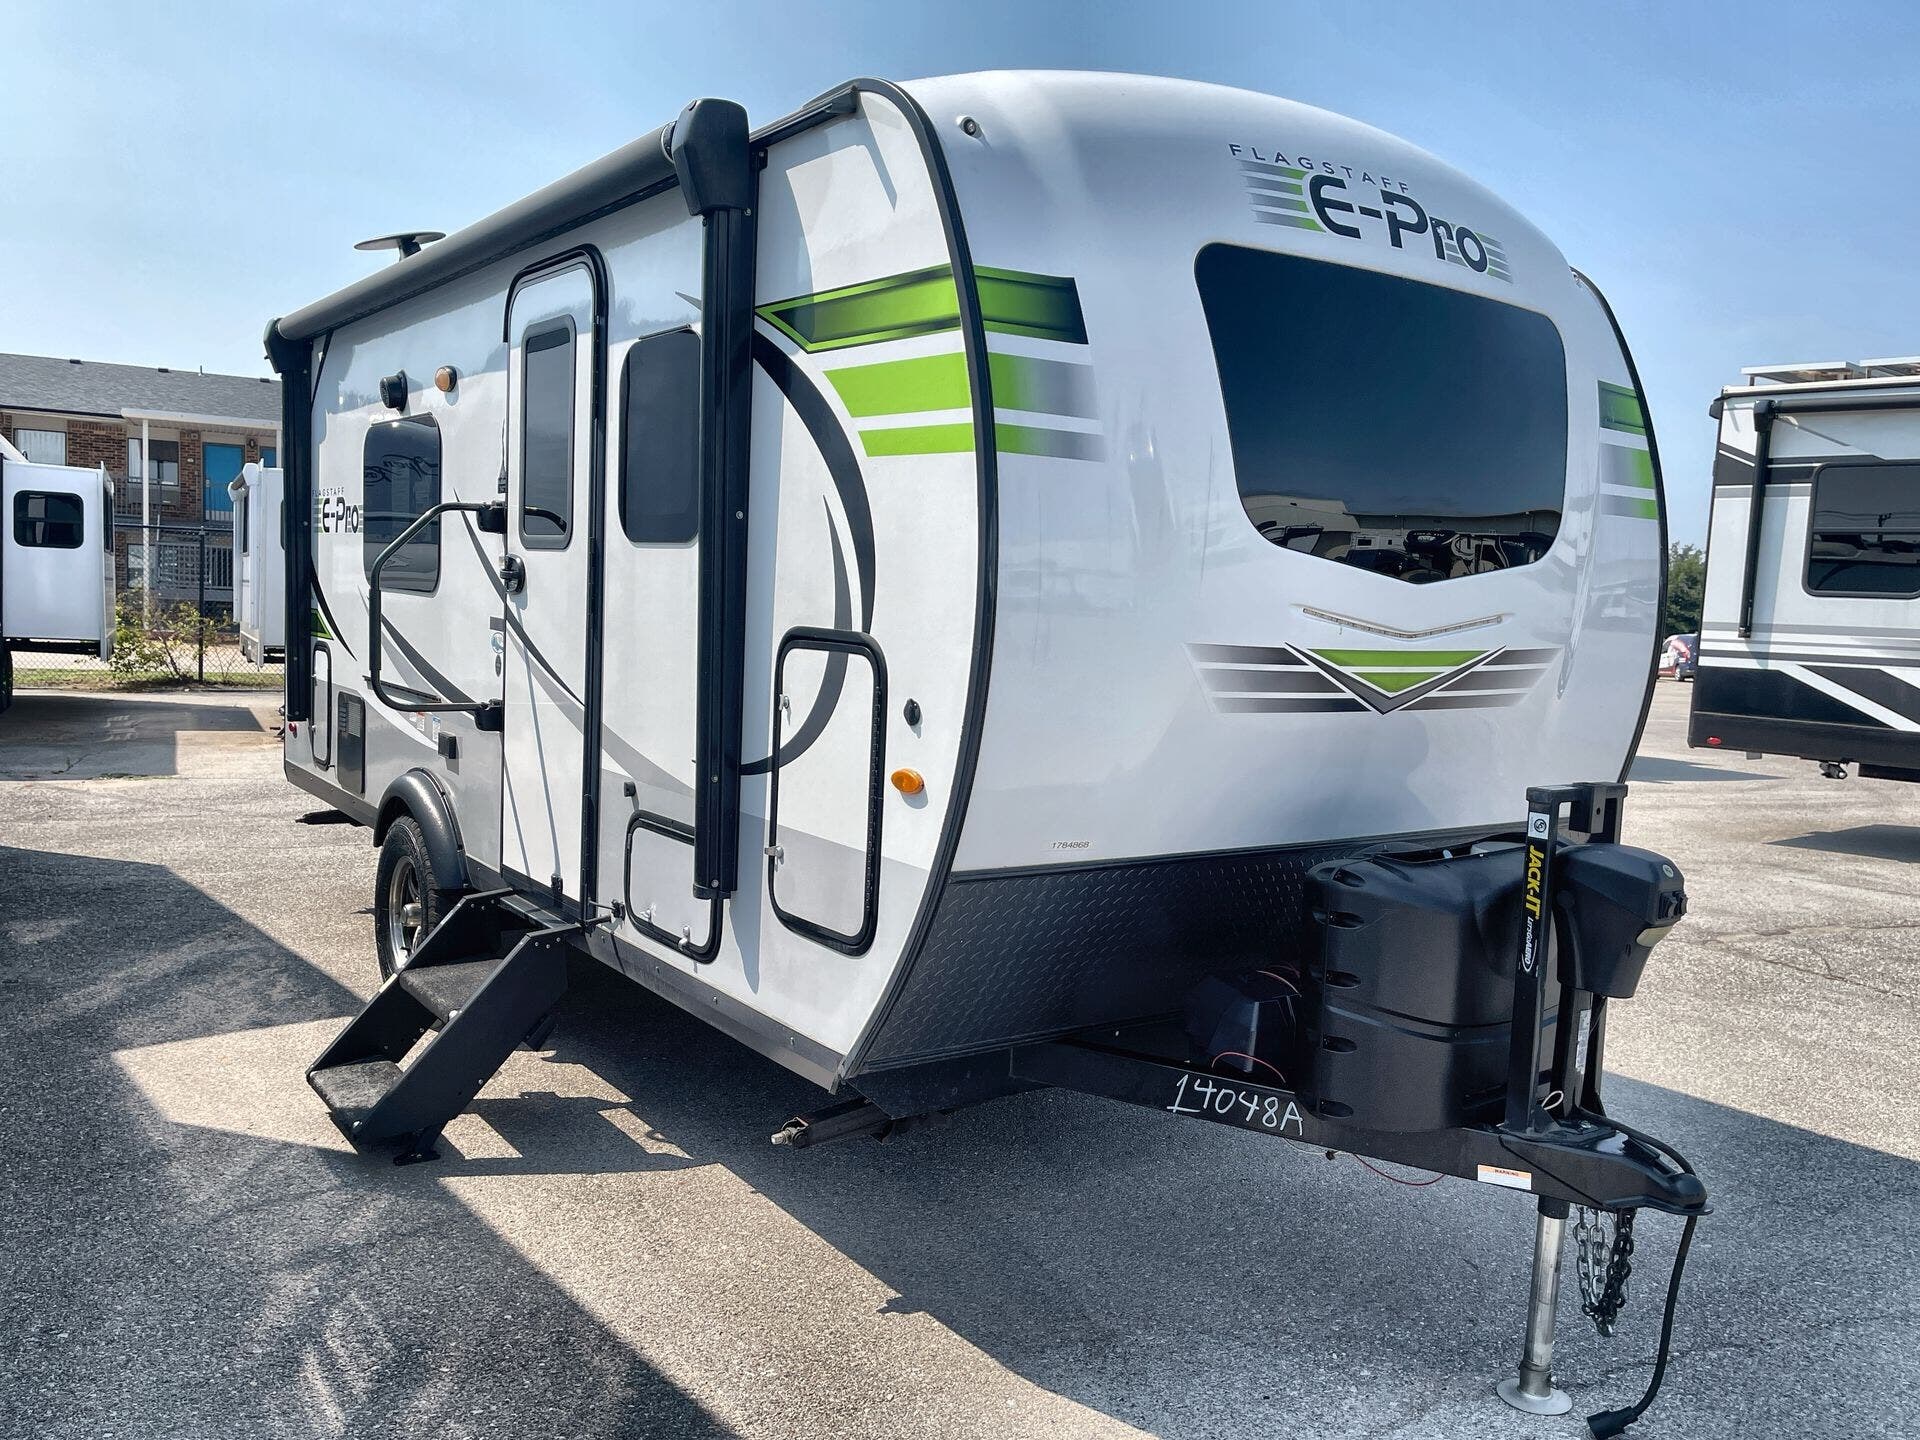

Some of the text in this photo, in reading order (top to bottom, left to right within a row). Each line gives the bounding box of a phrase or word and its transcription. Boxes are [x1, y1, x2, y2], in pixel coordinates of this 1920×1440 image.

[1229, 143, 1408, 193] FLAGSTAFF
[1308, 173, 1489, 273] E-Pro
[311, 486, 345, 497] FLAGSTAFF
[322, 496, 359, 533] E-Pro
[1526, 845, 1544, 917] JACK-IT
[1167, 1074, 1304, 1136] 14048A
[1494, 1169, 1520, 1177] WARNING
